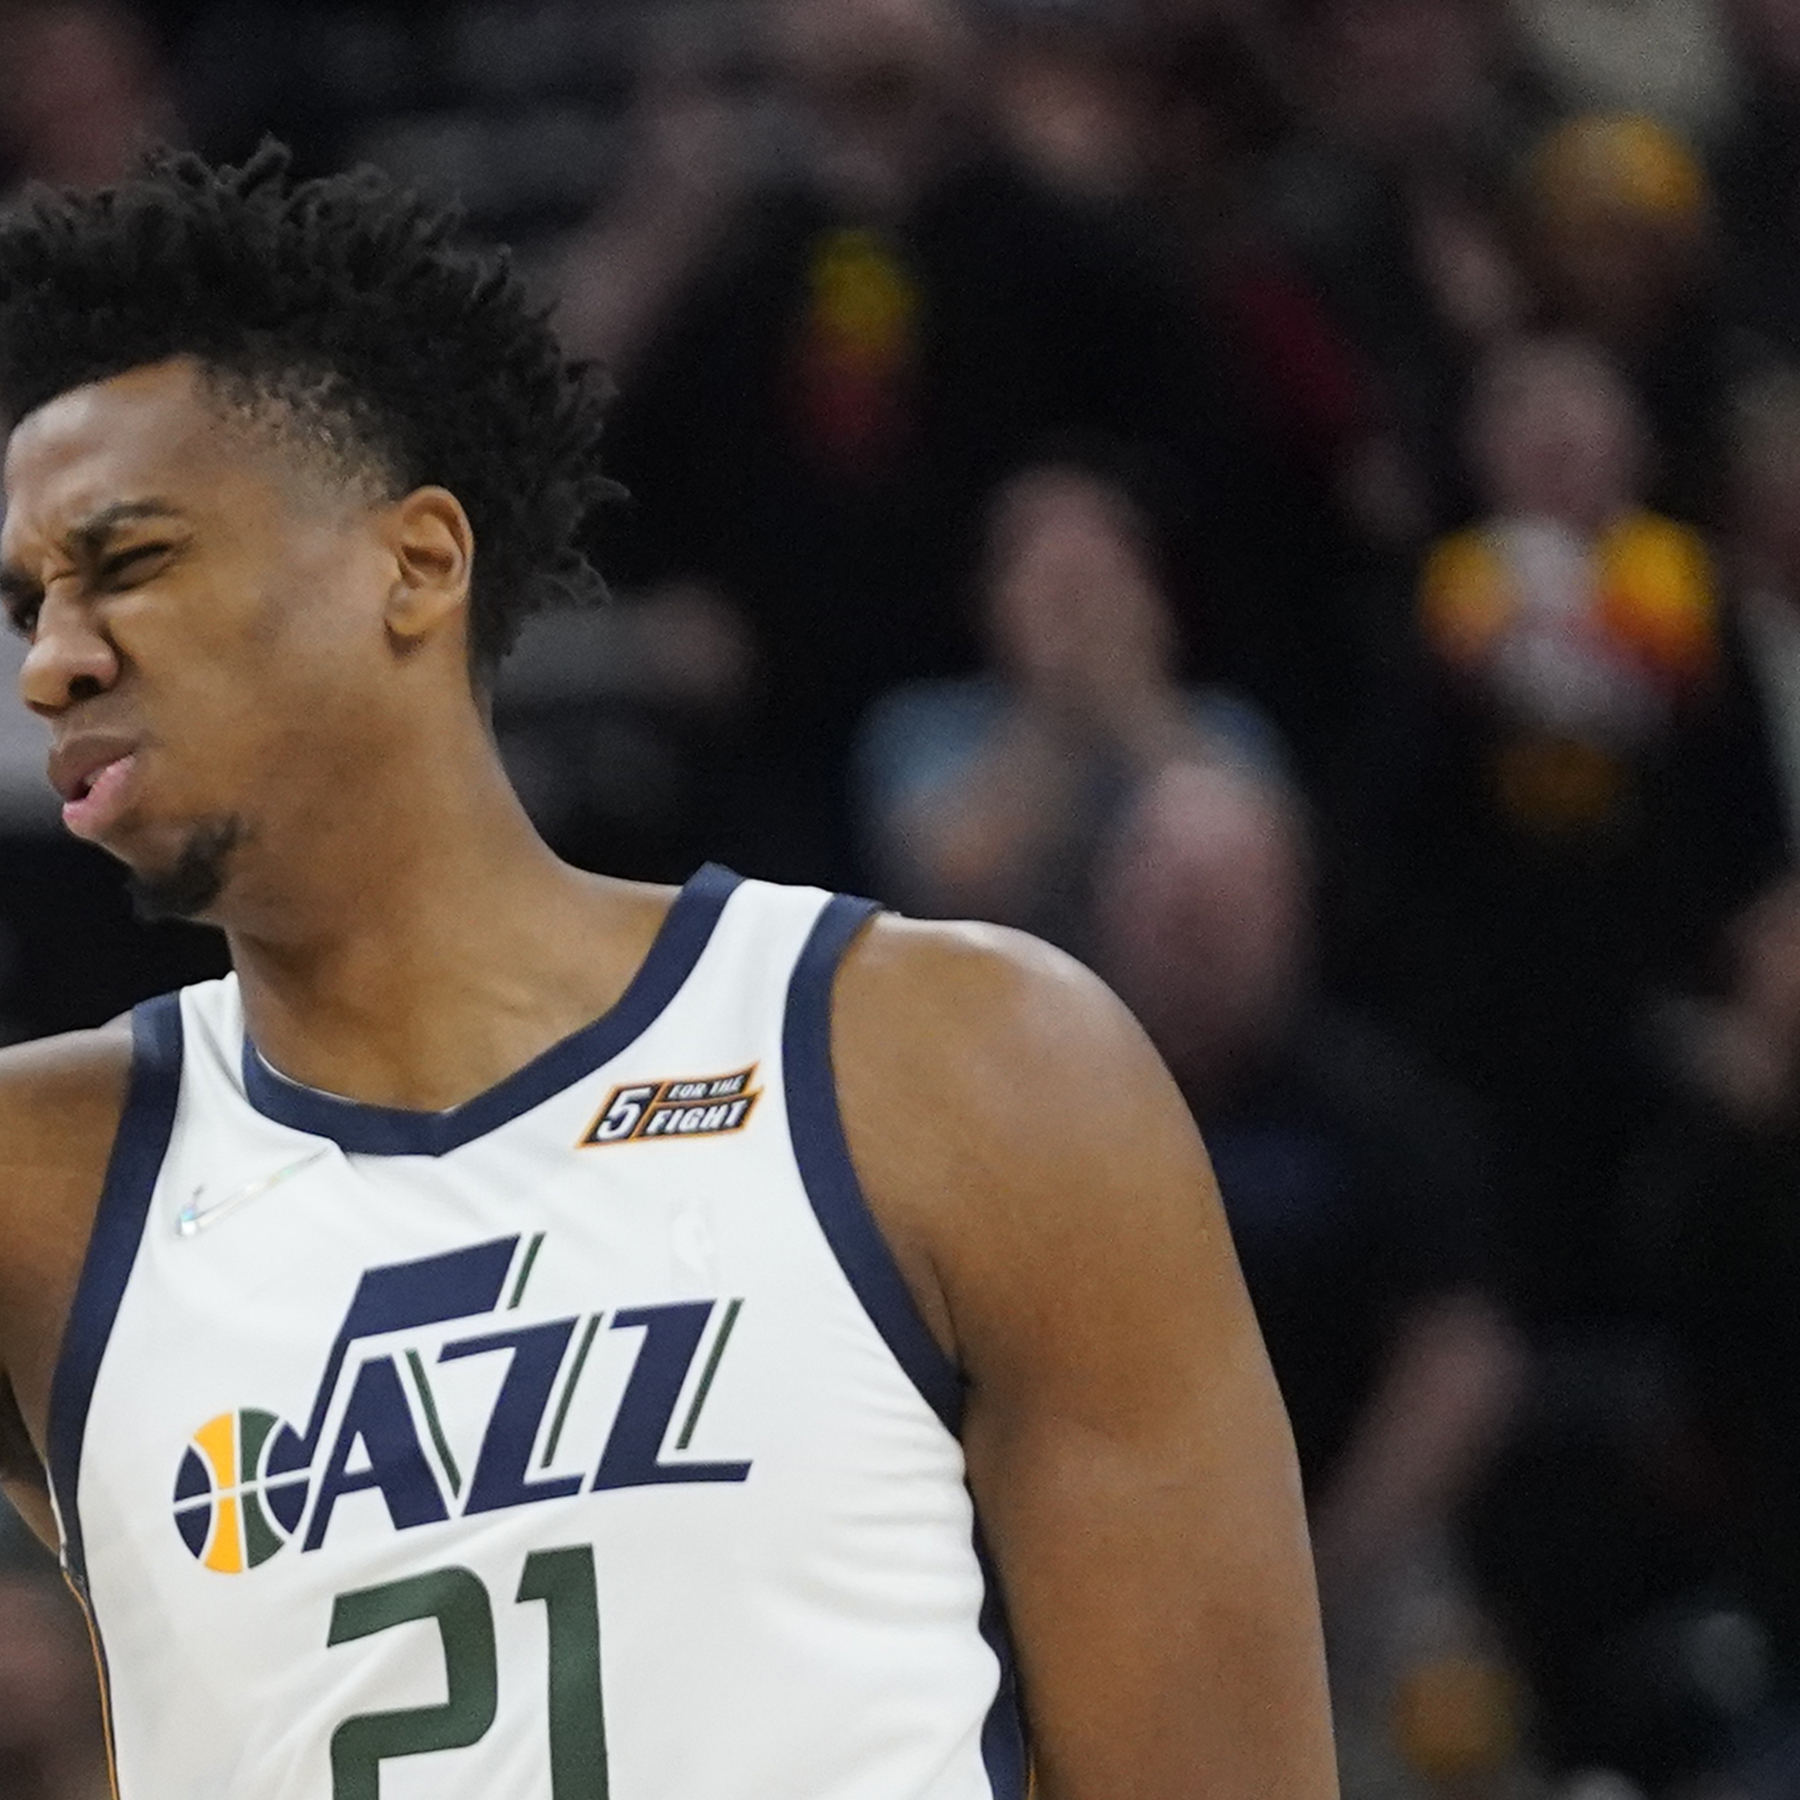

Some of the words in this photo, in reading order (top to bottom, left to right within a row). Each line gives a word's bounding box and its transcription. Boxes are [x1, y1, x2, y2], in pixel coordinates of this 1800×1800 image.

[668, 1082, 705, 1099] FOR
[710, 1075, 745, 1097] THE
[596, 1087, 652, 1140] 5
[646, 1100, 747, 1134] FIGHT
[173, 1232, 753, 1574] JAZZ
